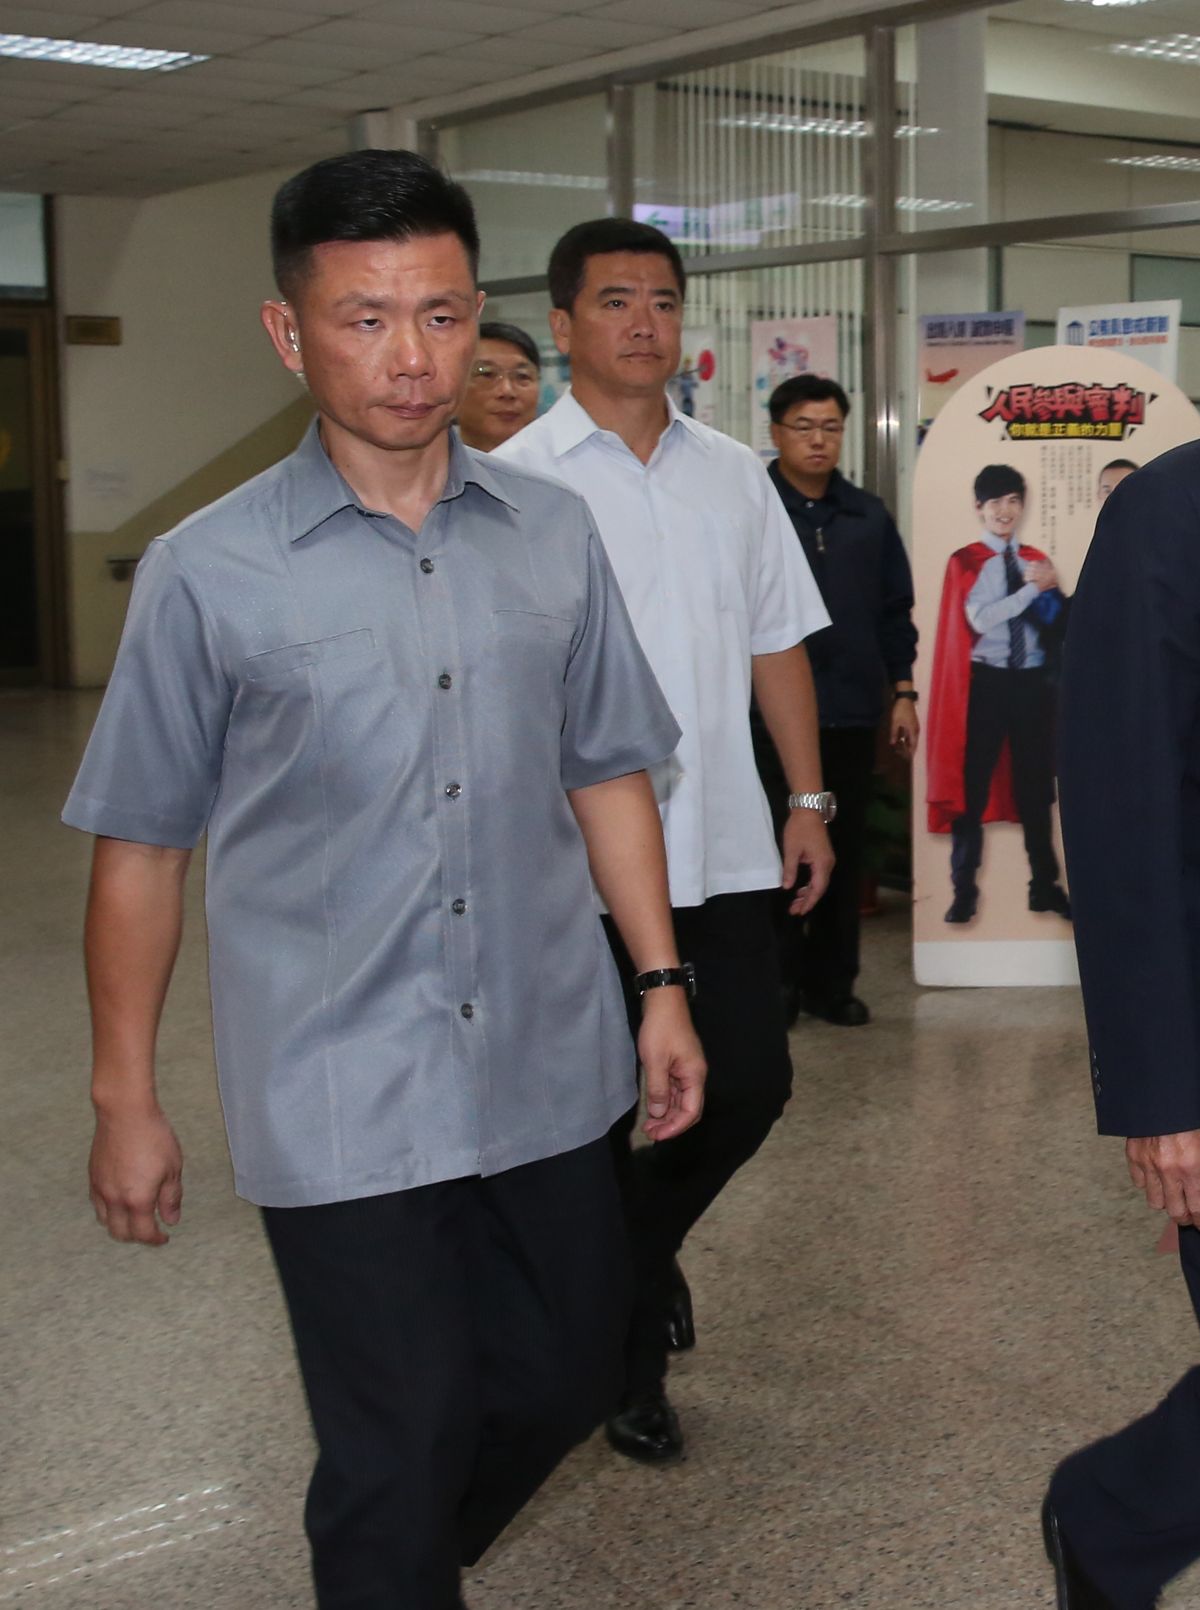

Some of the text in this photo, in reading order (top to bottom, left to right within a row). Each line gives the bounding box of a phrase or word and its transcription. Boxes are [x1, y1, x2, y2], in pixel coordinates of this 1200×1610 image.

[979, 383, 1145, 424] 人民參與審判
